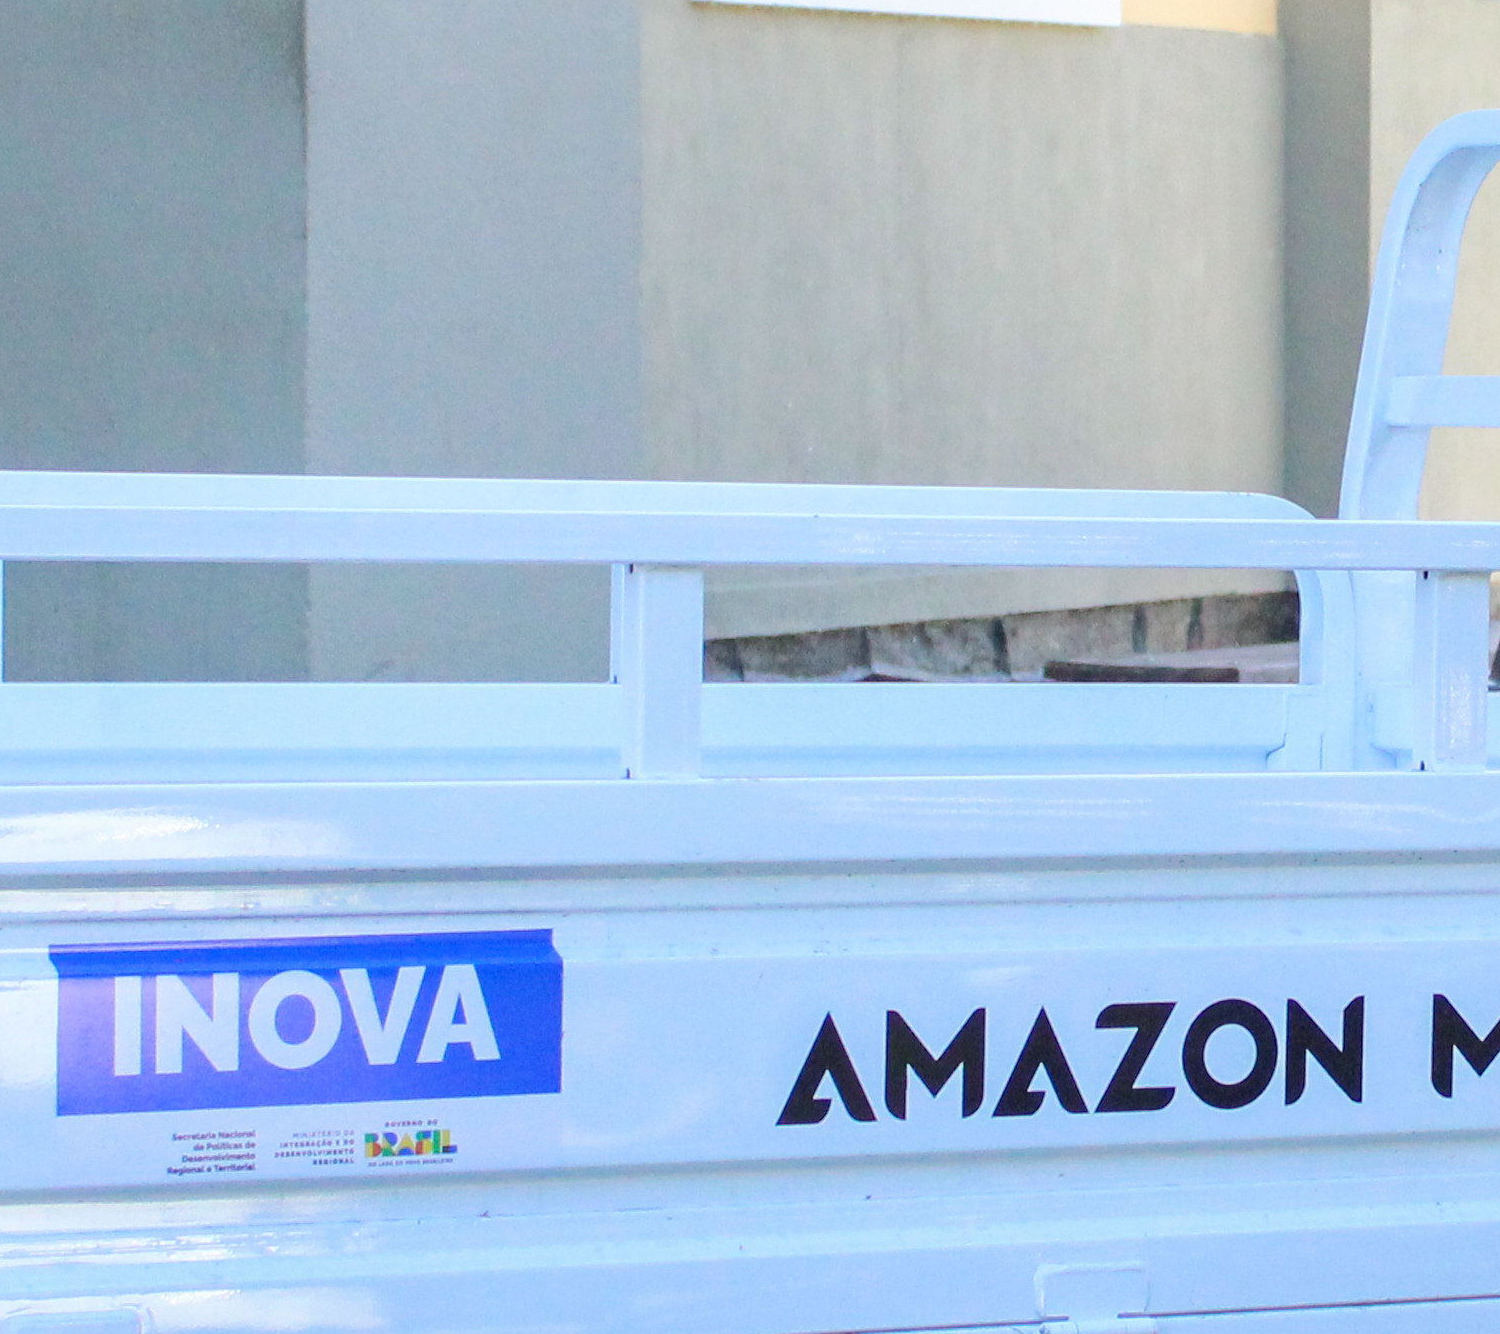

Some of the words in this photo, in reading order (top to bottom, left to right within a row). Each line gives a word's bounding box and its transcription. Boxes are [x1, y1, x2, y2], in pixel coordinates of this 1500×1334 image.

[113, 964, 501, 1077] INOVA
[777, 995, 1364, 1126] AMAZON
[364, 1129, 458, 1158] BRASIL
